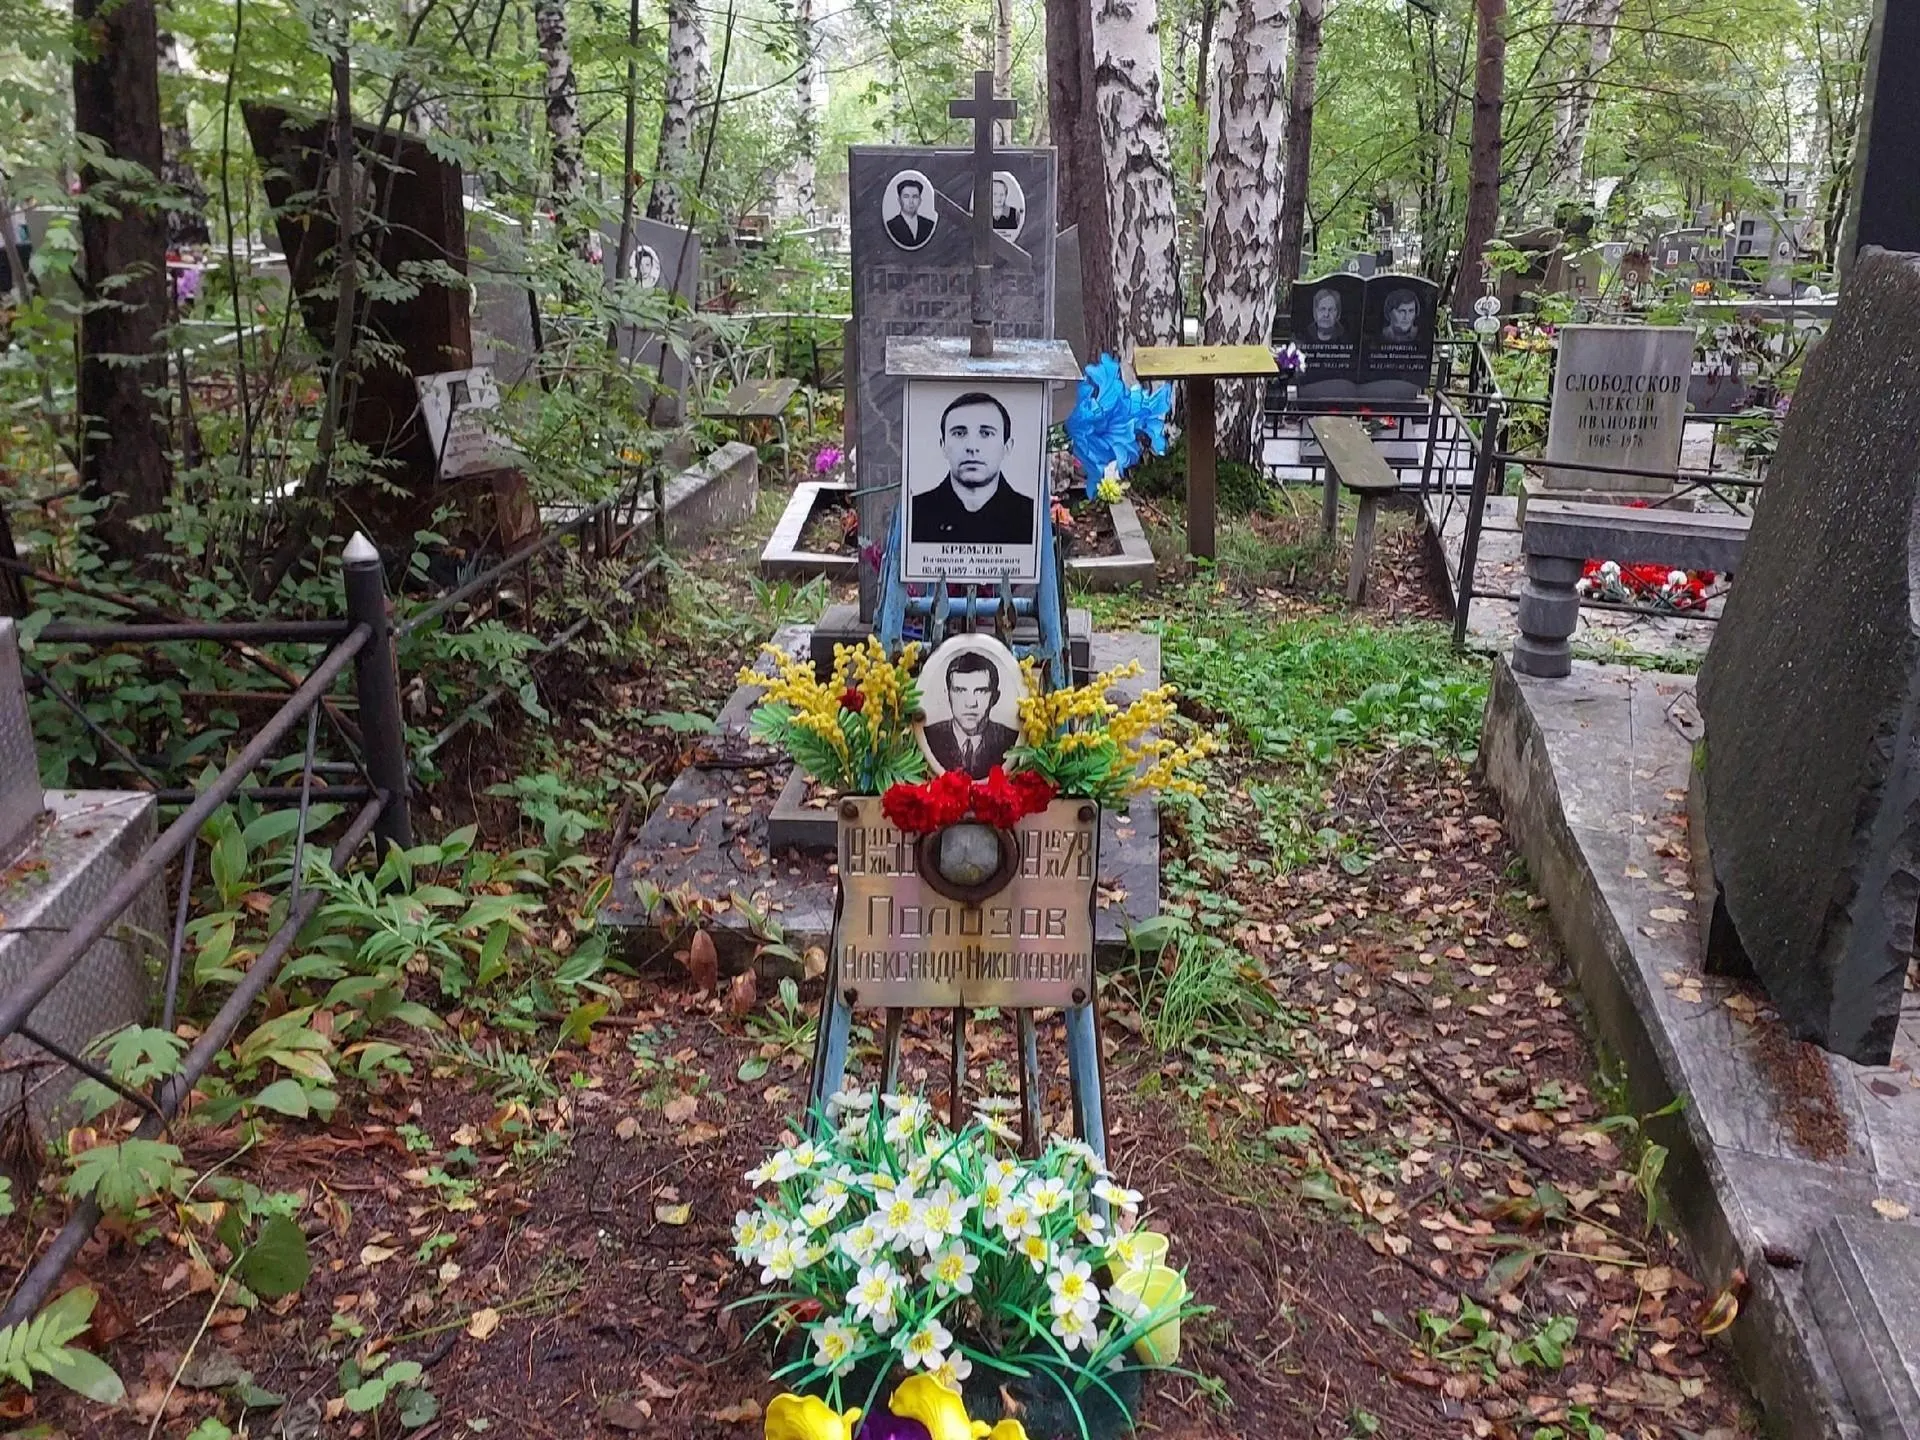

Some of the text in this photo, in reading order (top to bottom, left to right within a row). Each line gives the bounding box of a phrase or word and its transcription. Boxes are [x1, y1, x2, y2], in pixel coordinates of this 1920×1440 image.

[1565, 373, 1681, 394] СЛОБОДСКОВ
[1578, 415, 1659, 430] ИВАНОВИЧ
[941, 544, 1003, 555] КРЕМЛЕВ
